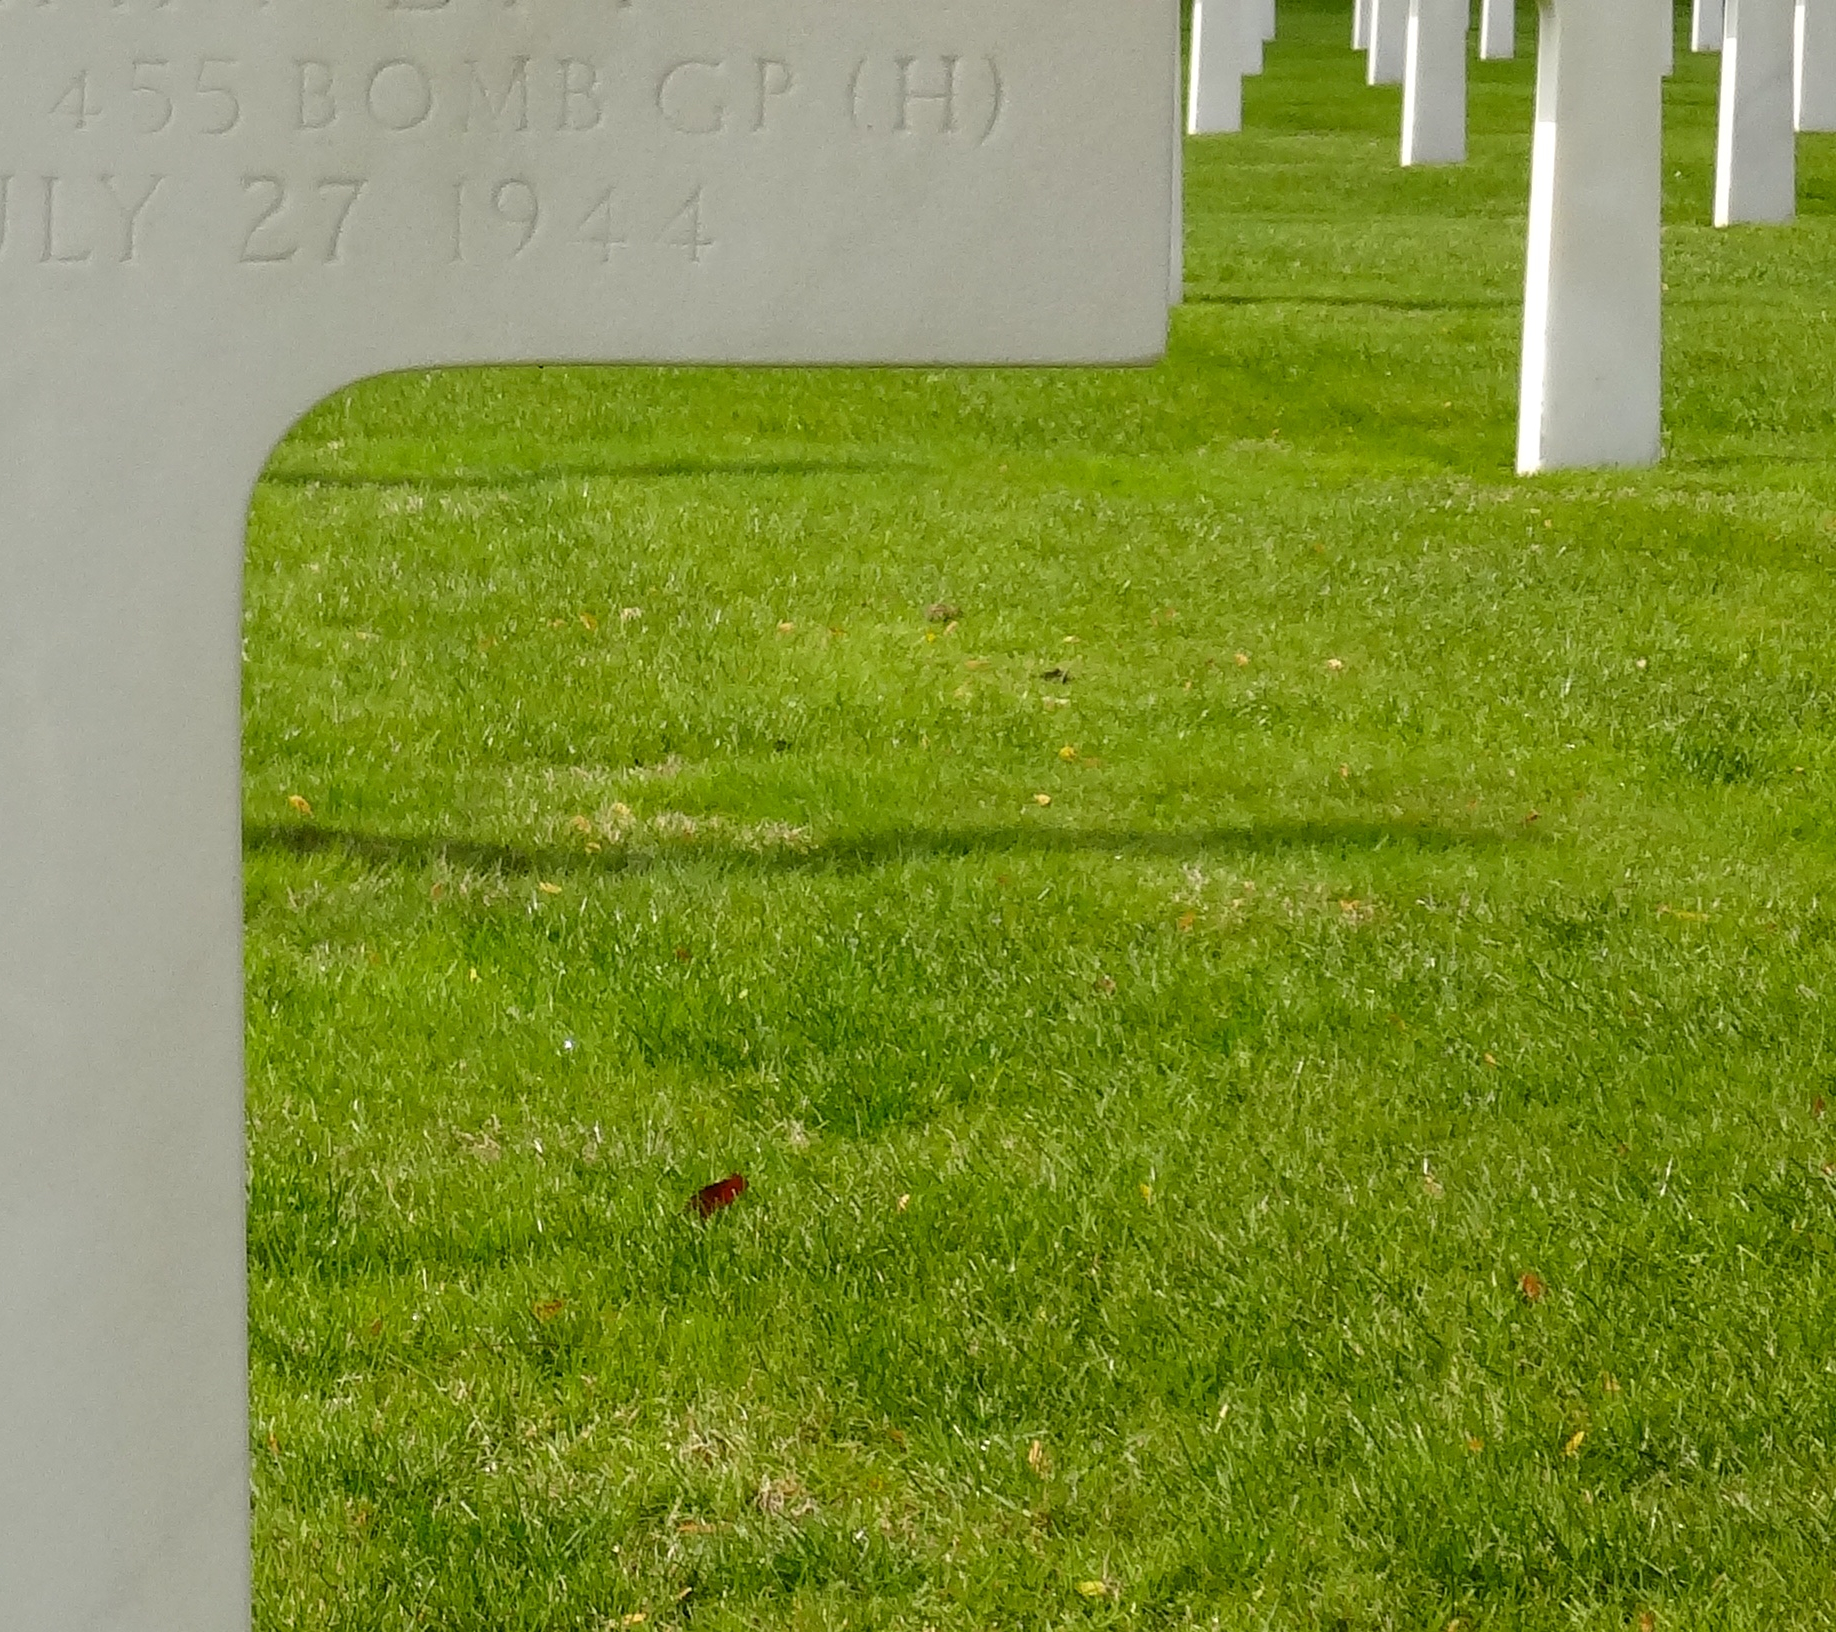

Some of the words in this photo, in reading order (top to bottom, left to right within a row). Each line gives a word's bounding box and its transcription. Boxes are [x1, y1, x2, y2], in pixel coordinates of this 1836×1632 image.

[47, 57, 241, 136] 455
[293, 55, 603, 134] BOMB
[655, 56, 795, 135] GP
[847, 54, 1006, 147] (H)
[238, 174, 368, 264] 27
[451, 177, 715, 264] 1944
